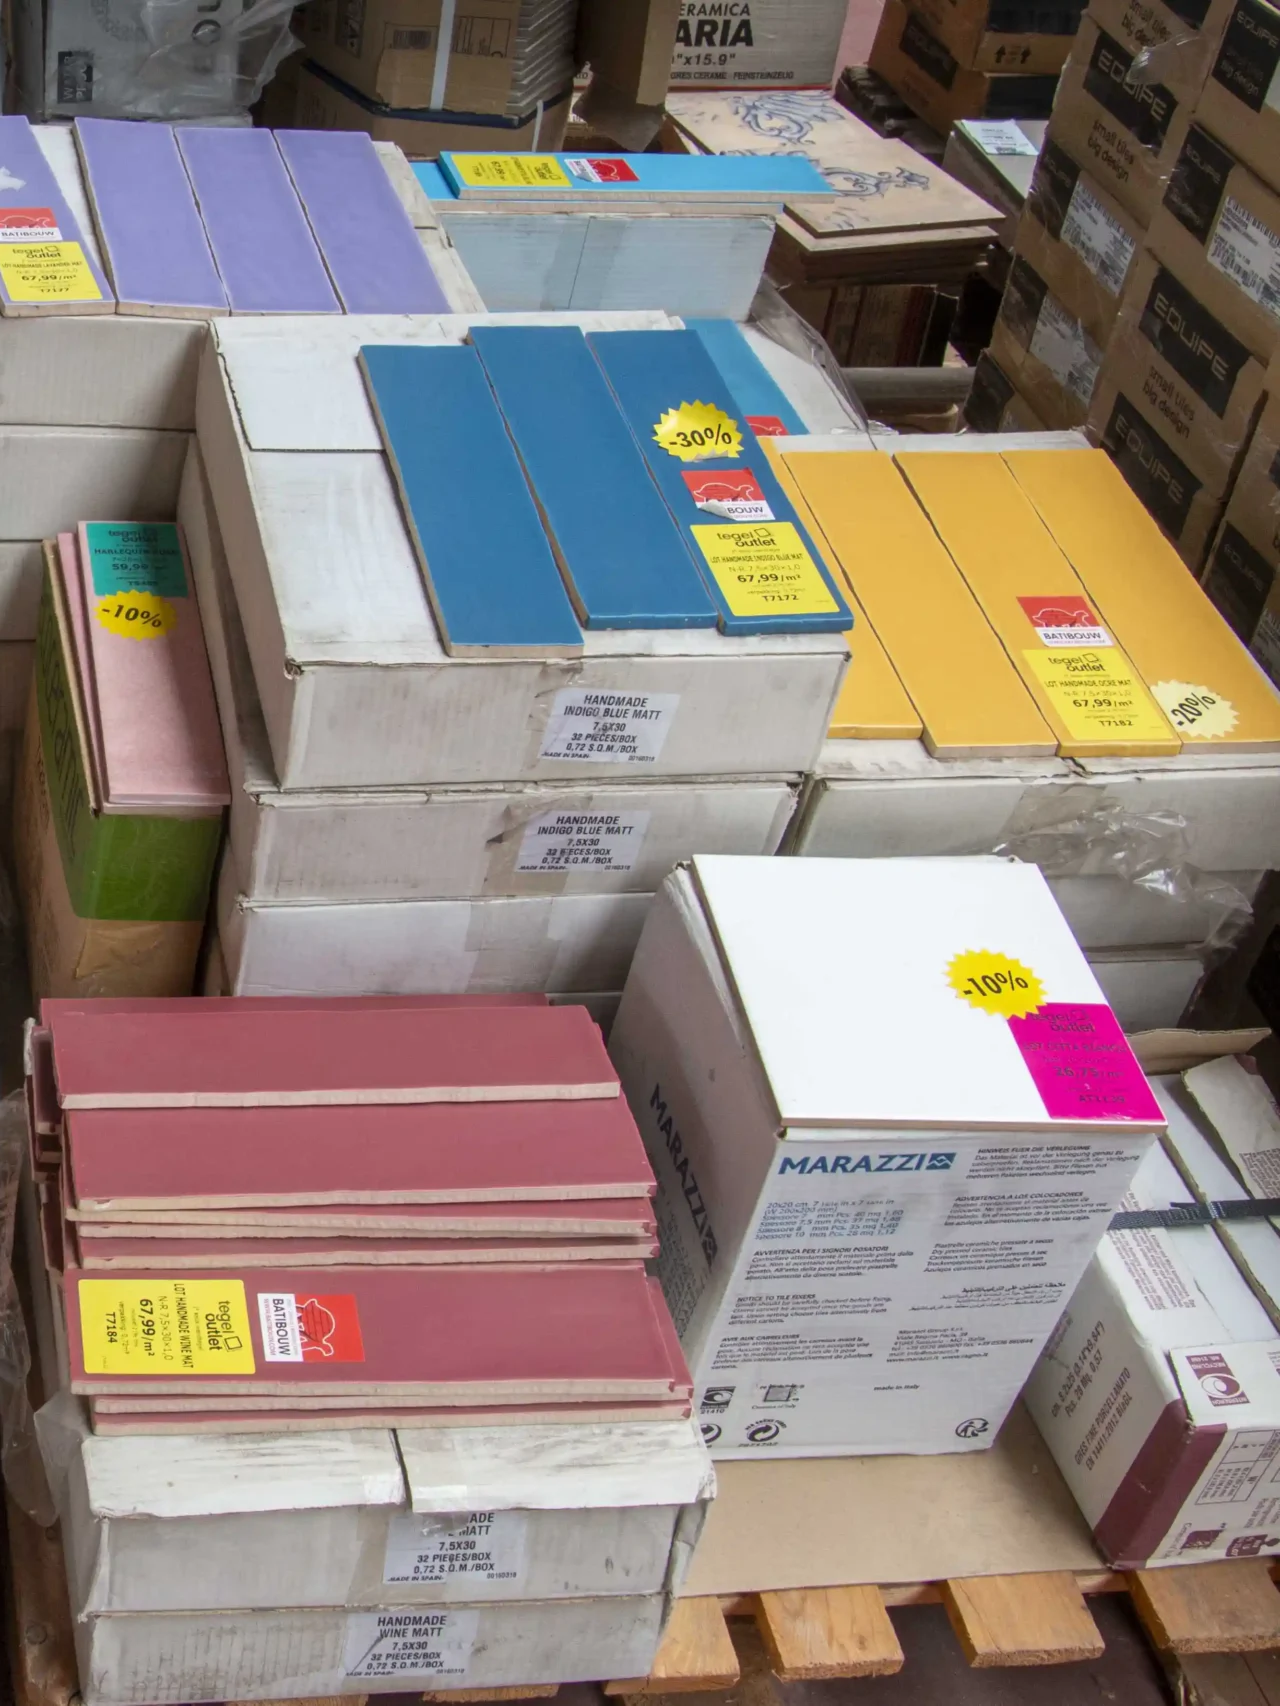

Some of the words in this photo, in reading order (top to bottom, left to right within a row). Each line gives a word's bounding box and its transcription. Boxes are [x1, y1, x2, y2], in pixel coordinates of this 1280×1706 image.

[679, 3, 751, 17] ERAMICA
[1093, 119, 1117, 144] small
[1087, 136, 1102, 158] big
[1101, 148, 1130, 182] design
[1153, 292, 1229, 382] EQUIPE
[1148, 363, 1174, 396] small
[1141, 381, 1160, 405] big
[1157, 398, 1192, 440] design
[669, 424, 732, 448] -30%
[1115, 412, 1184, 505] EQUIPE
[727, 505, 763, 514] BOUW
[717, 530, 754, 541] tegel
[735, 537, 776, 547] outlet
[722, 554, 753, 562] HANDMADE
[737, 573, 801, 583] 67,99/m²
[762, 594, 799, 602] T7172
[101, 604, 162, 628] -10%
[1043, 631, 1101, 639] BATIBOUW
[1049, 656, 1083, 666] tegel
[1067, 662, 1105, 672] outlet
[1099, 679, 1117, 687] OCRE
[1118, 679, 1131, 687] MAT
[583, 694, 648, 707] HANDMADE
[1073, 698, 1133, 708] 67,99/m²
[563, 706, 599, 717] INDIGO
[603, 707, 629, 718] BLUE
[632, 709, 662, 720] MATT
[1171, 692, 1216, 727] -20%
[593, 721, 626, 733] 7,5X30
[571, 732, 583, 741] 32
[585, 733, 637, 743] PIECES/BOX
[566, 742, 586, 752] 0,72
[556, 816, 620, 825] HANDMADE
[537, 826, 573, 835] INDIGO
[576, 826, 602, 835] BLUE
[605, 826, 634, 835] MATT
[567, 838, 600, 847] 7,5X30
[963, 970, 1029, 997] -10%
[650, 1082, 708, 1237] MARAZZI
[778, 1153, 925, 1175] MARAZZI
[173, 1283, 184, 1295] LOT
[175, 1296, 189, 1334] HANDMADE
[217, 1300, 233, 1335] tegel
[105, 1311, 118, 1343] T7184
[139, 1298, 155, 1357] 67,99/m²
[205, 1313, 223, 1351] outlet
[273, 1298, 291, 1356] BATIBOUW
[181, 1334, 192, 1354] WINE
[185, 1354, 194, 1369] MAT
[1095, 1367, 1131, 1427] PORCELLANATO
[439, 1540, 476, 1551] 7,5X30
[417, 1555, 429, 1563] 32
[432, 1552, 491, 1563] PIECES/BOX
[377, 1615, 447, 1626] HANDMADE
[379, 1628, 408, 1638] WINE
[412, 1627, 443, 1637] MATT
[392, 1641, 428, 1651] 7,5X30
[385, 1652, 441, 1661] PIECES/BOX
[366, 1662, 387, 1670] 0,72
